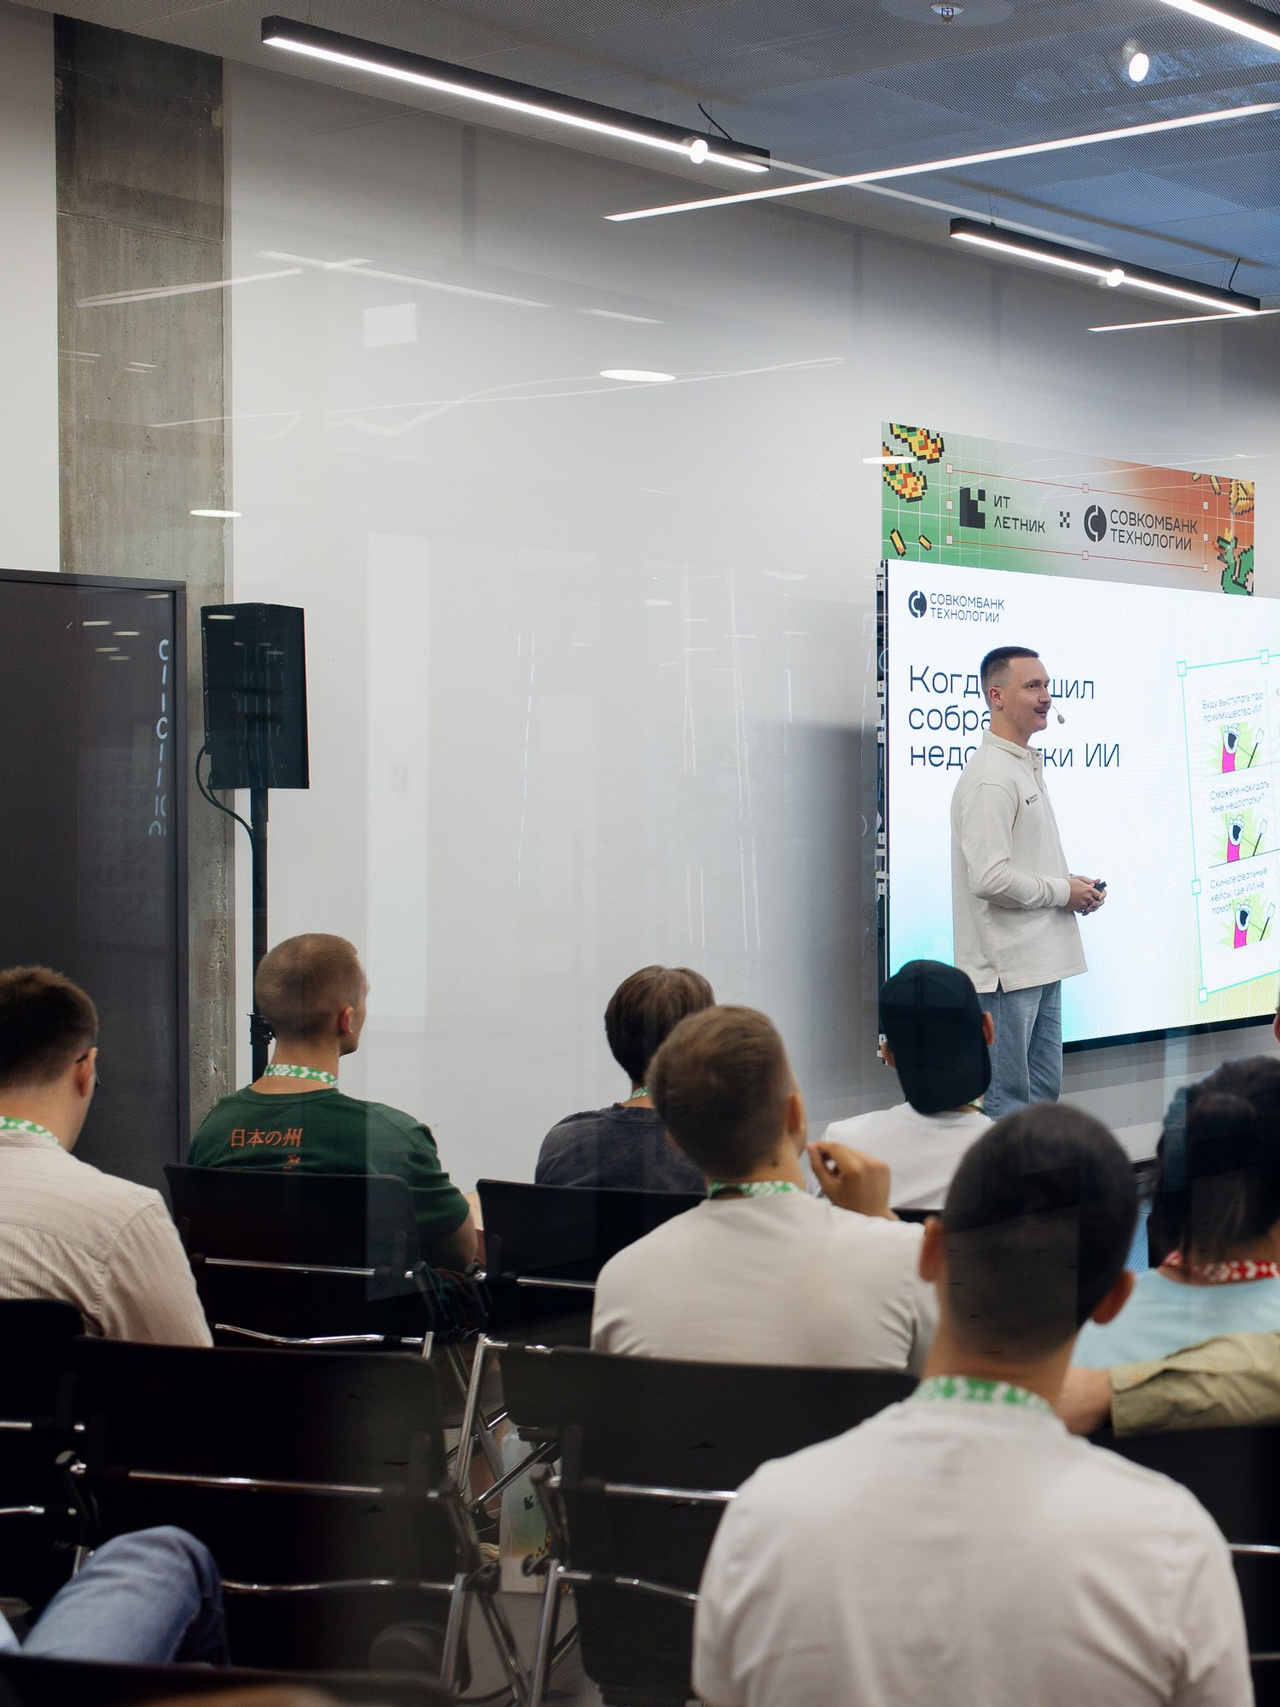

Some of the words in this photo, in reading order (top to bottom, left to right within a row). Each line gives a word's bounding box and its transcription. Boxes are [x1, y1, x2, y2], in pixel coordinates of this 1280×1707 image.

[994, 494, 1011, 509] ИТ
[993, 515, 1046, 534] ЛЕТНИК
[1109, 509, 1199, 535] СОВКОМБАНК
[1110, 528, 1192, 551] ТЕХНОЛОГИИ
[929, 592, 1005, 611] СОВКОМБАНК
[930, 607, 1000, 623] ТЕХНОЛОГИИ
[909, 664, 982, 698] Когд
[908, 704, 991, 736] собра
[910, 745, 1073, 770] недоки
[1085, 743, 1120, 767] ИИ
[230, 1128, 303, 1148] 日本の州
